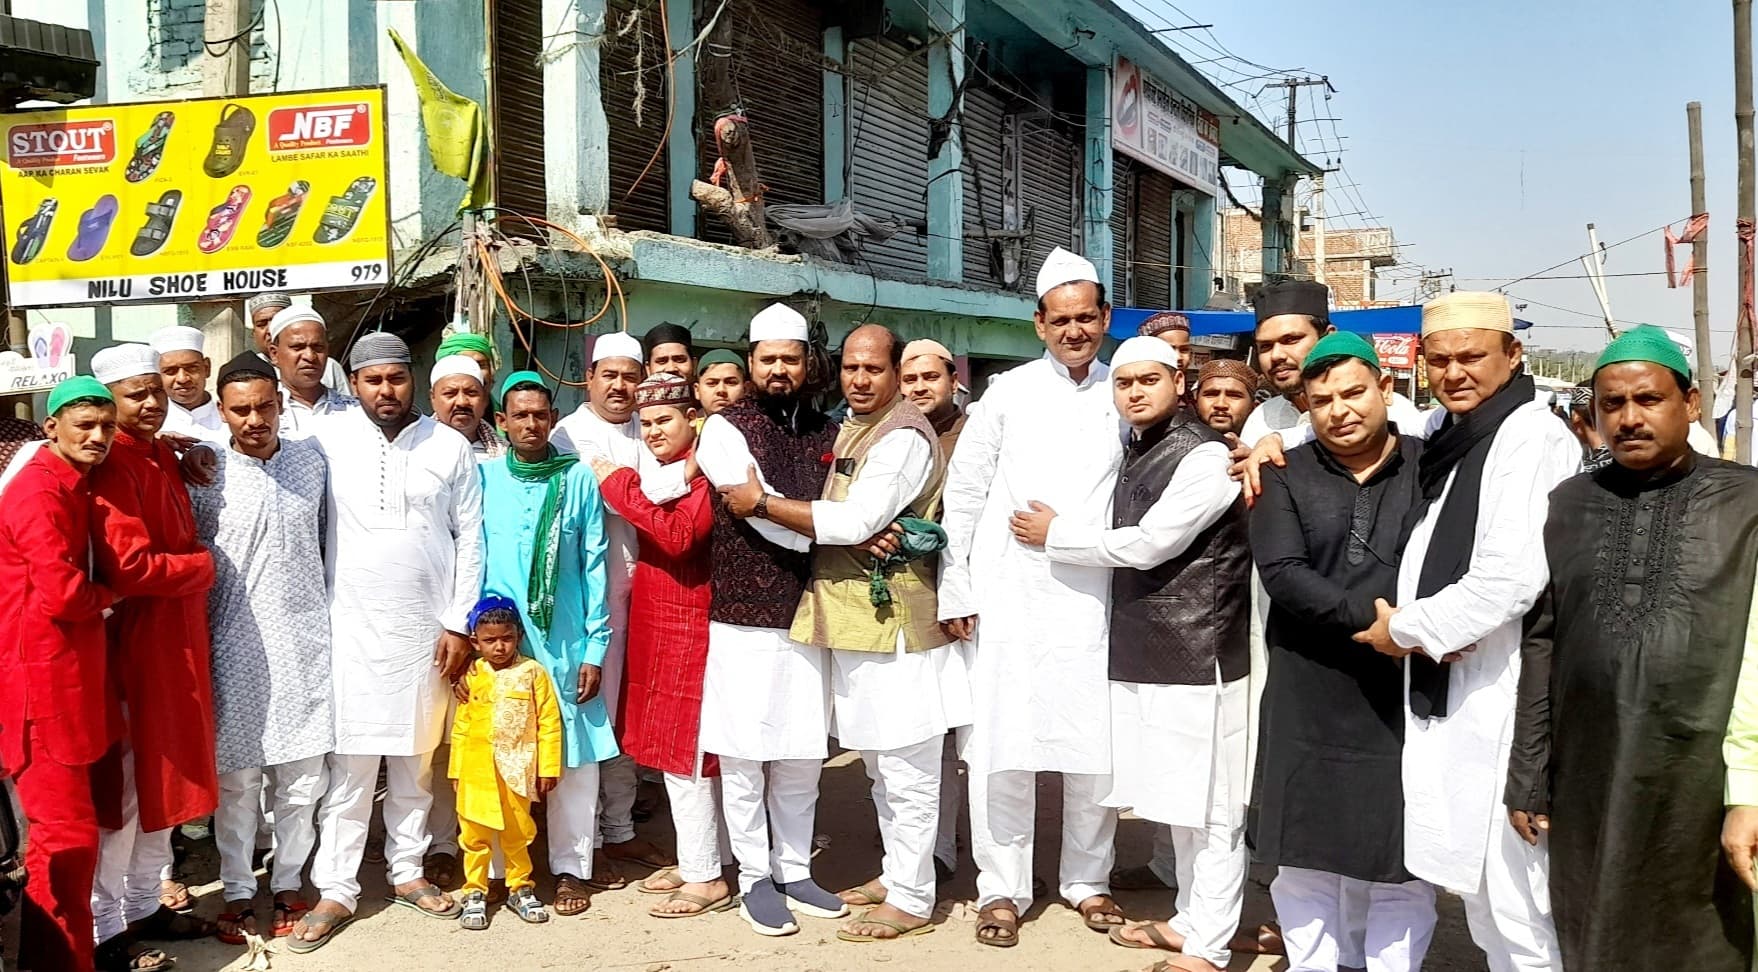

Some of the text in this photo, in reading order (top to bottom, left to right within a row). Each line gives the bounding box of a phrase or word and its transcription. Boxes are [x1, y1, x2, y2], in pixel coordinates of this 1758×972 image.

[278, 108, 356, 141] NBF
[12, 127, 106, 153] STOUT
[271, 149, 369, 163] LAMBE SAFAR KA SAATHI
[18, 166, 110, 178] AAP KA CHARAN SEVAK
[87, 264, 382, 298] NILU SHOE HOUSE 979
[1375, 335, 1412, 354] Cola
[11, 371, 68, 387] RELAXO
